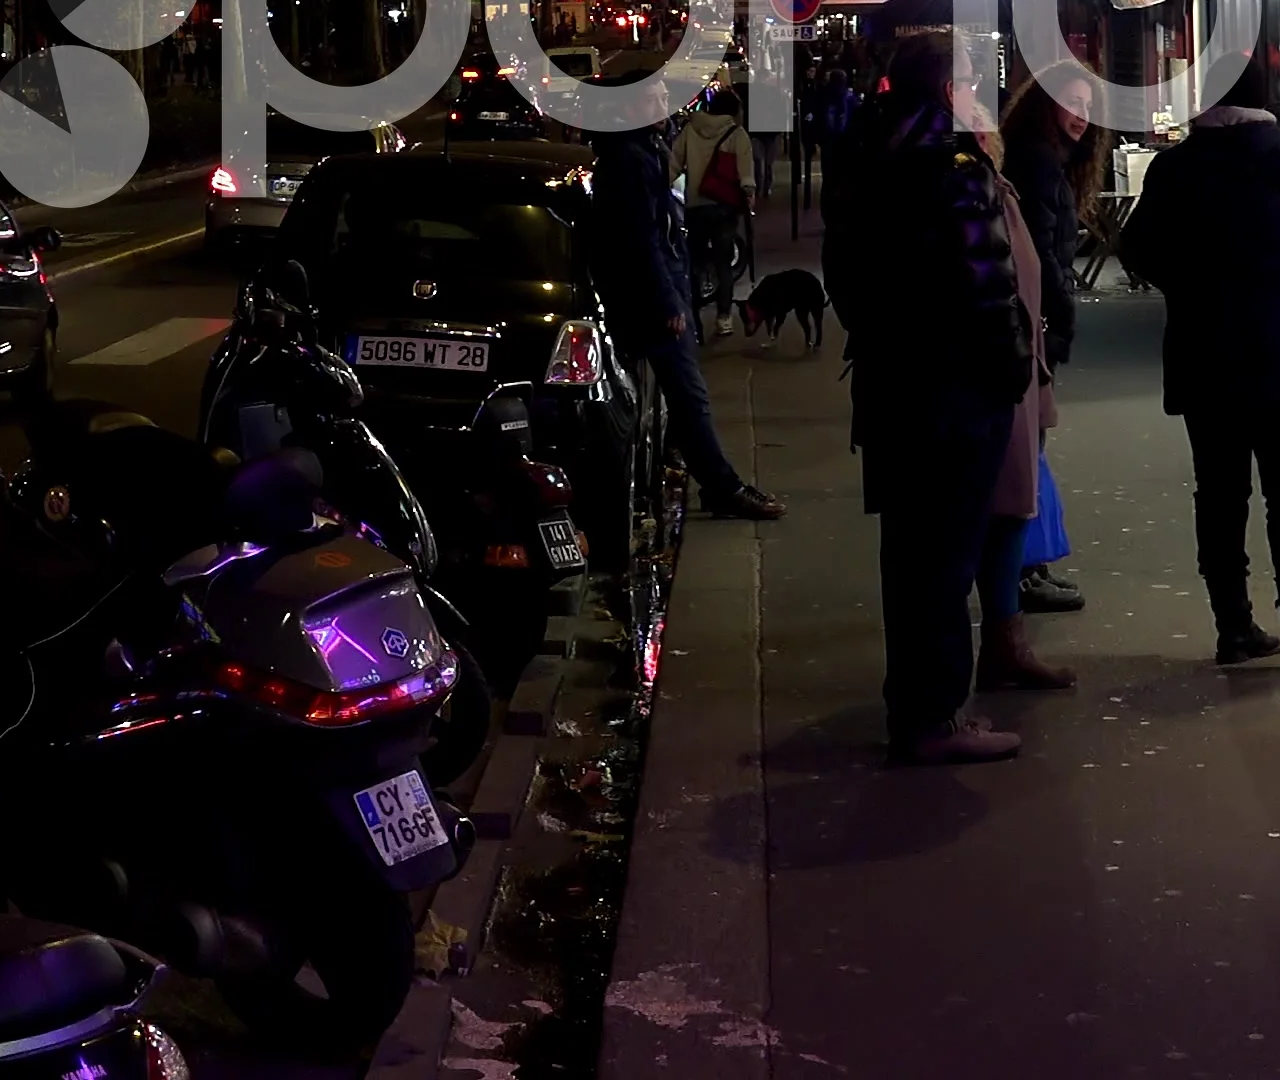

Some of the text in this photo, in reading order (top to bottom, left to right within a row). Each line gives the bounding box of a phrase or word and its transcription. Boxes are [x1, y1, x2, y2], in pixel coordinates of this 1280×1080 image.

[772, 27, 800, 39] SAUF
[359, 340, 486, 368] 5096 WT 28
